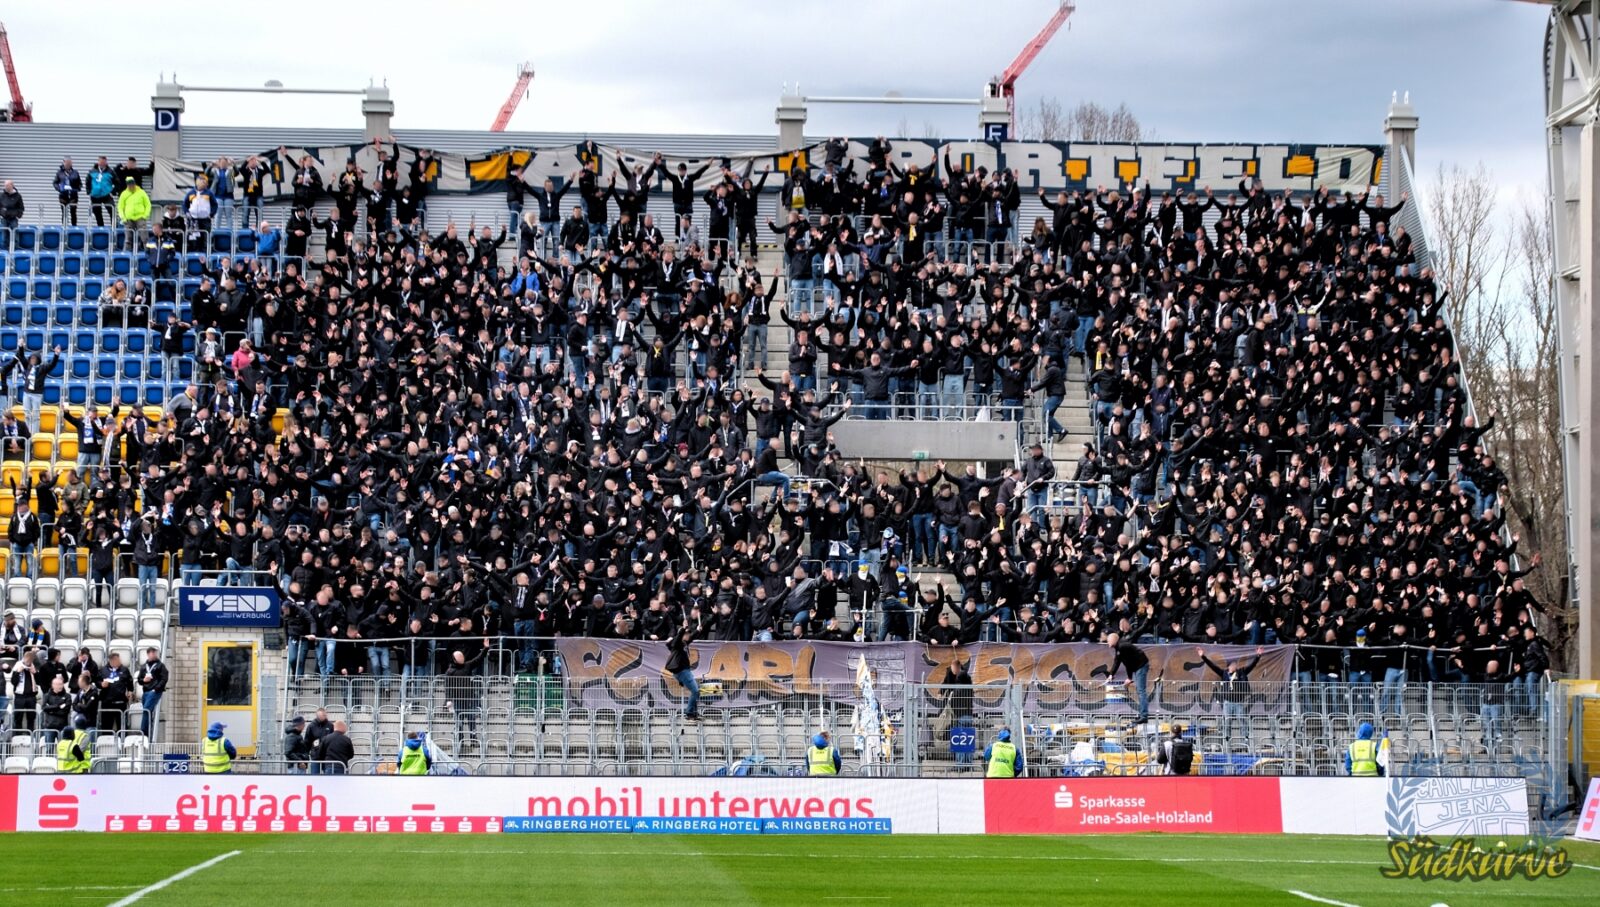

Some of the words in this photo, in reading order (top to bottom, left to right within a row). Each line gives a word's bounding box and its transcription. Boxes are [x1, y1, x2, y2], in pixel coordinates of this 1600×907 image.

[158, 111, 175, 129] D
[556, 638, 655, 708] FC
[951, 734, 975, 746] C27
[163, 761, 188, 772] C26
[176, 785, 327, 817] einfach
[528, 786, 642, 817] mobil
[658, 790, 874, 818] unterwegs
[1079, 795, 1146, 810] Sparkasse
[1079, 810, 1213, 825] Jena-Saale-Holzland
[522, 820, 587, 830] RINGBERG
[590, 820, 630, 831] HOTEL
[652, 820, 716, 830] RINGBERG
[720, 820, 760, 831] HOTEL
[782, 820, 846, 830] RINGBERG
[849, 820, 890, 831] HOTEL
